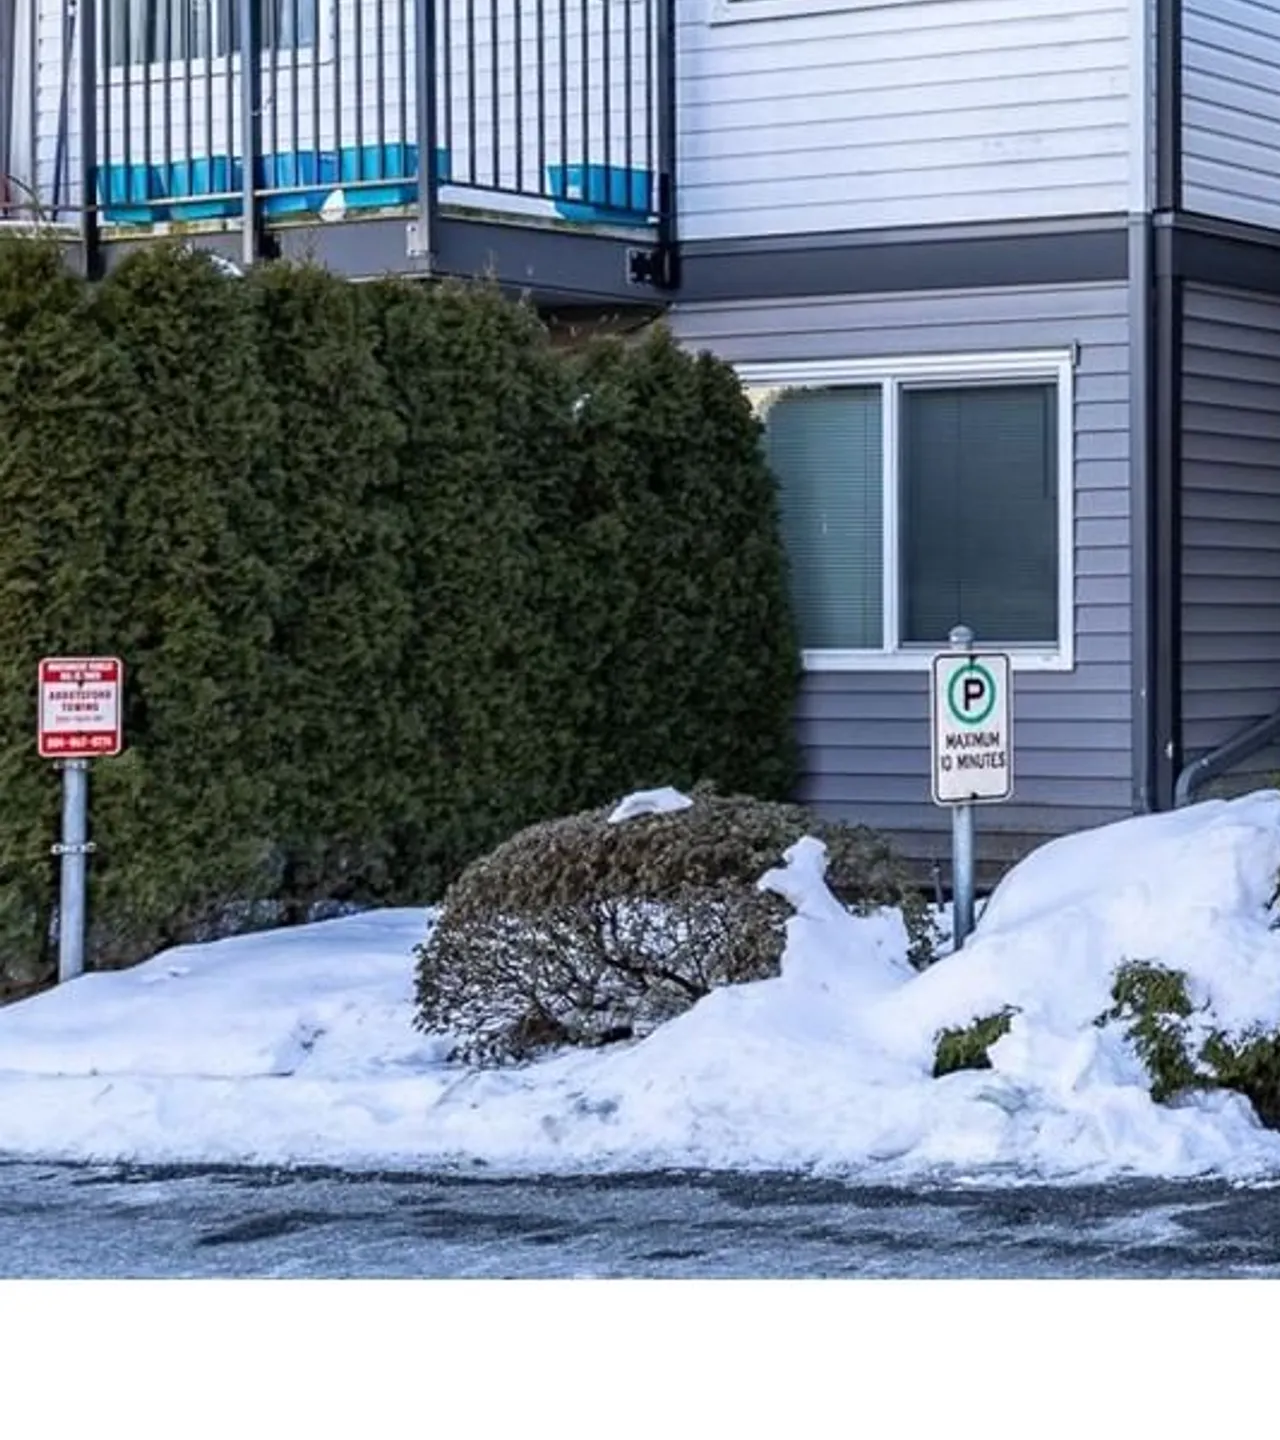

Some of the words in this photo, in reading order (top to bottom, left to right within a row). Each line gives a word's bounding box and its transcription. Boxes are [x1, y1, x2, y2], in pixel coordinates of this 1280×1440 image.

[963, 679, 985, 712] P
[945, 731, 1000, 749] MAXIMUM
[957, 751, 1005, 770] MINUTES
